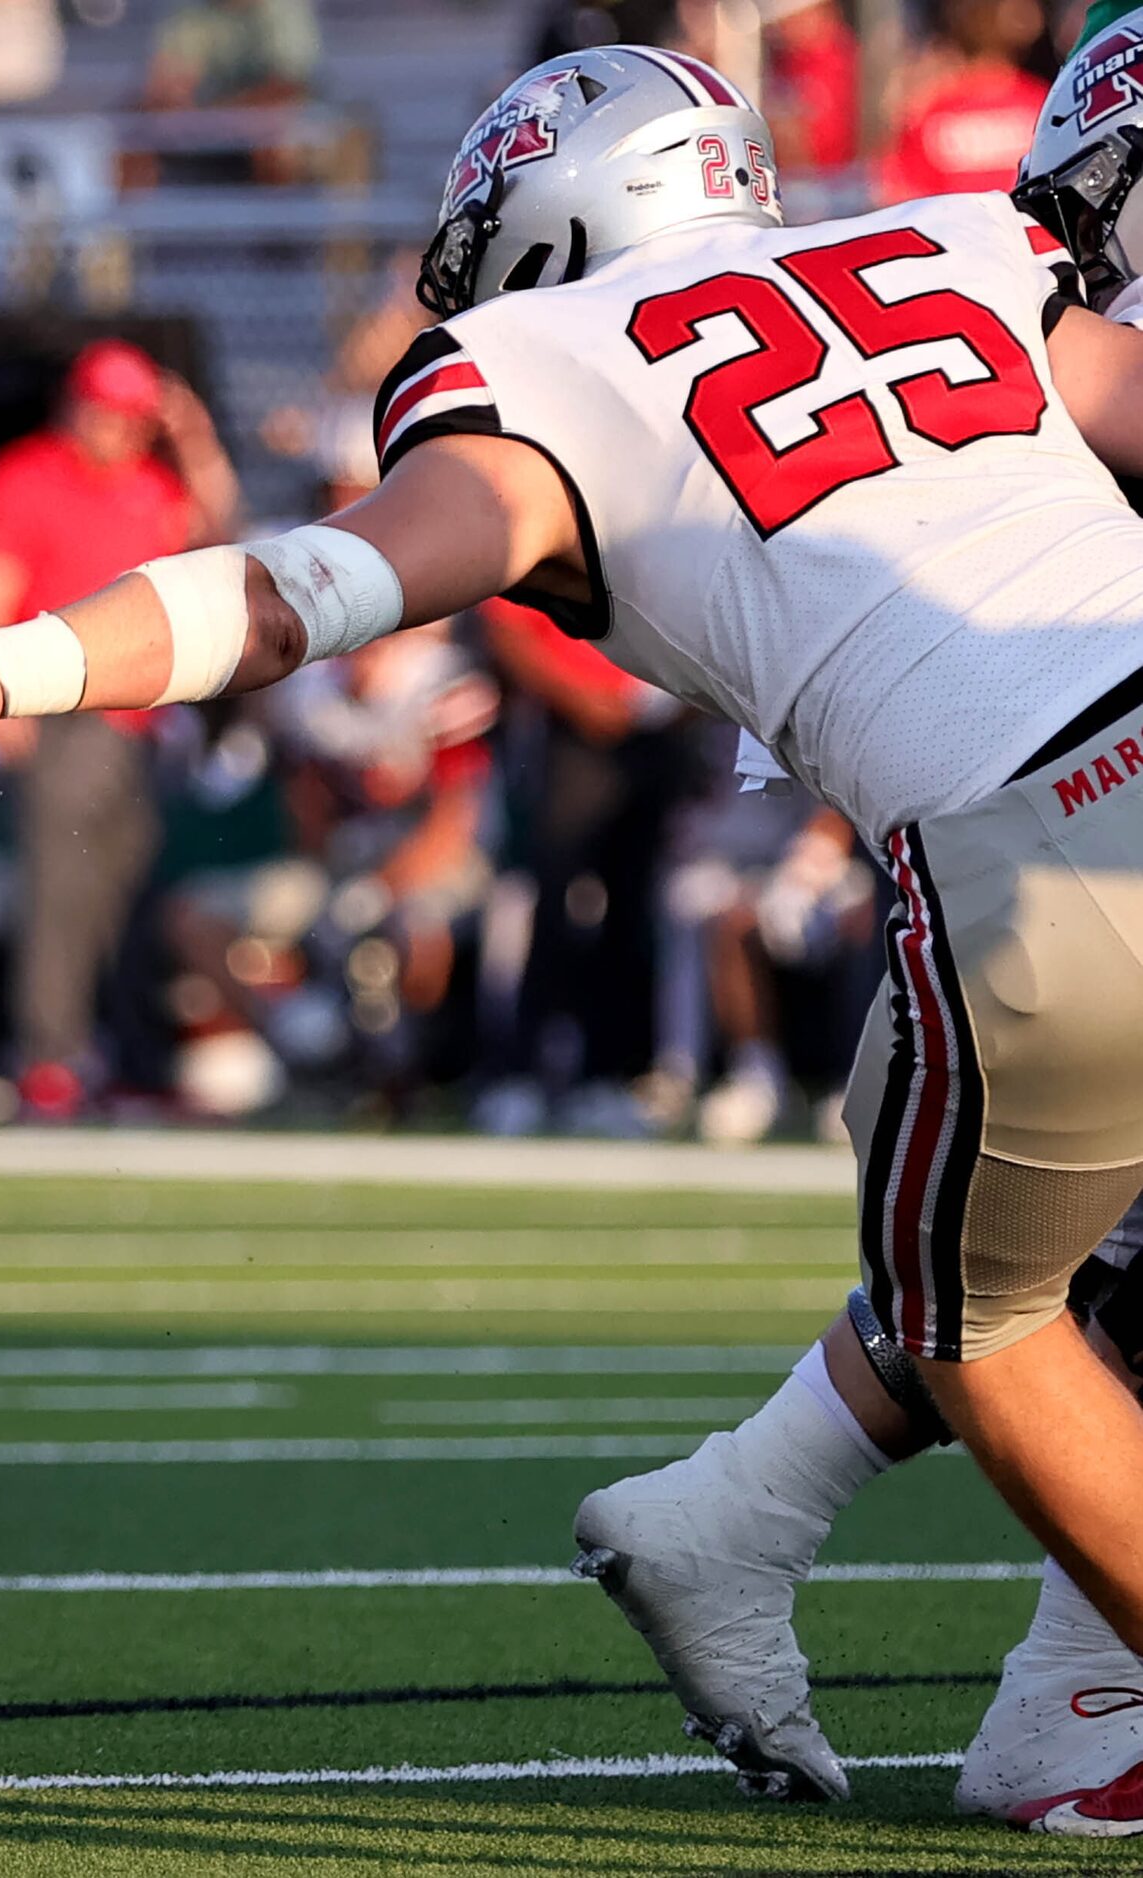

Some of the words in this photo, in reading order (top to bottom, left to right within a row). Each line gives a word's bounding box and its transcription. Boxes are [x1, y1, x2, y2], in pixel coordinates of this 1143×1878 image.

[697, 134, 771, 206] 25
[626, 227, 1048, 542] 25
[1051, 725, 1143, 818] MAR
